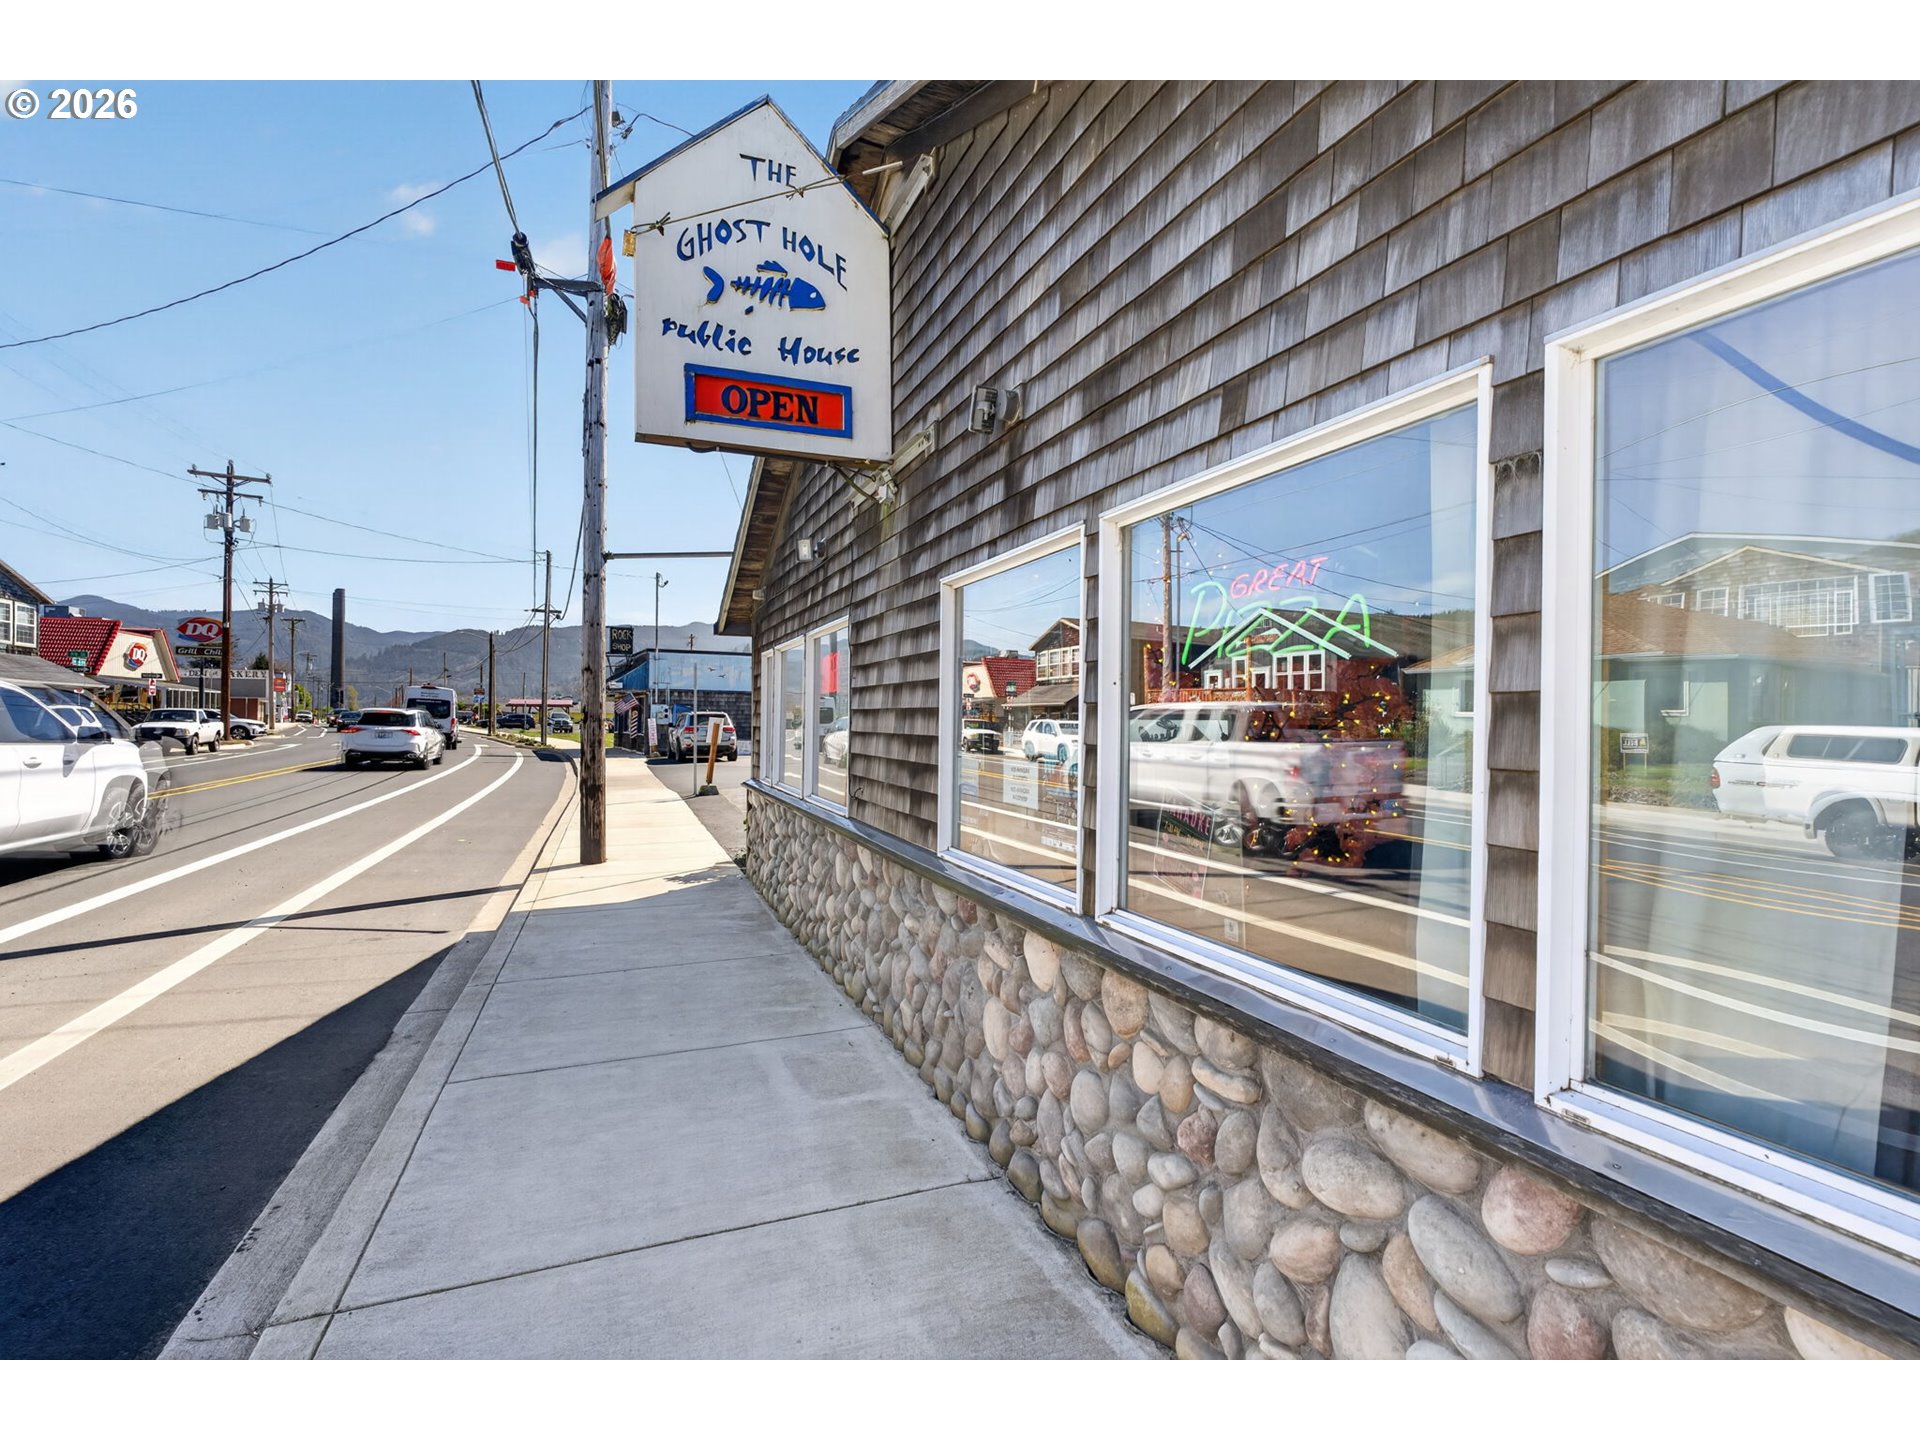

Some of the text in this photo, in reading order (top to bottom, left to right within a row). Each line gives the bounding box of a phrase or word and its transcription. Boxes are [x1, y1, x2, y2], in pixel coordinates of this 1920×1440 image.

[739, 153, 797, 188] THE
[676, 218, 848, 291] GHOST HOLE
[777, 336, 860, 366] House
[721, 384, 819, 425] OPEN
[1229, 556, 1329, 599] GREAT
[185, 622, 219, 638] DQ
[611, 628, 633, 640] ROCK
[132, 648, 147, 661] DQ
[203, 647, 223, 656] Chil
[612, 642, 632, 652] SHOP
[188, 669, 208, 678] DEI
[230, 669, 268, 679] AKERY
